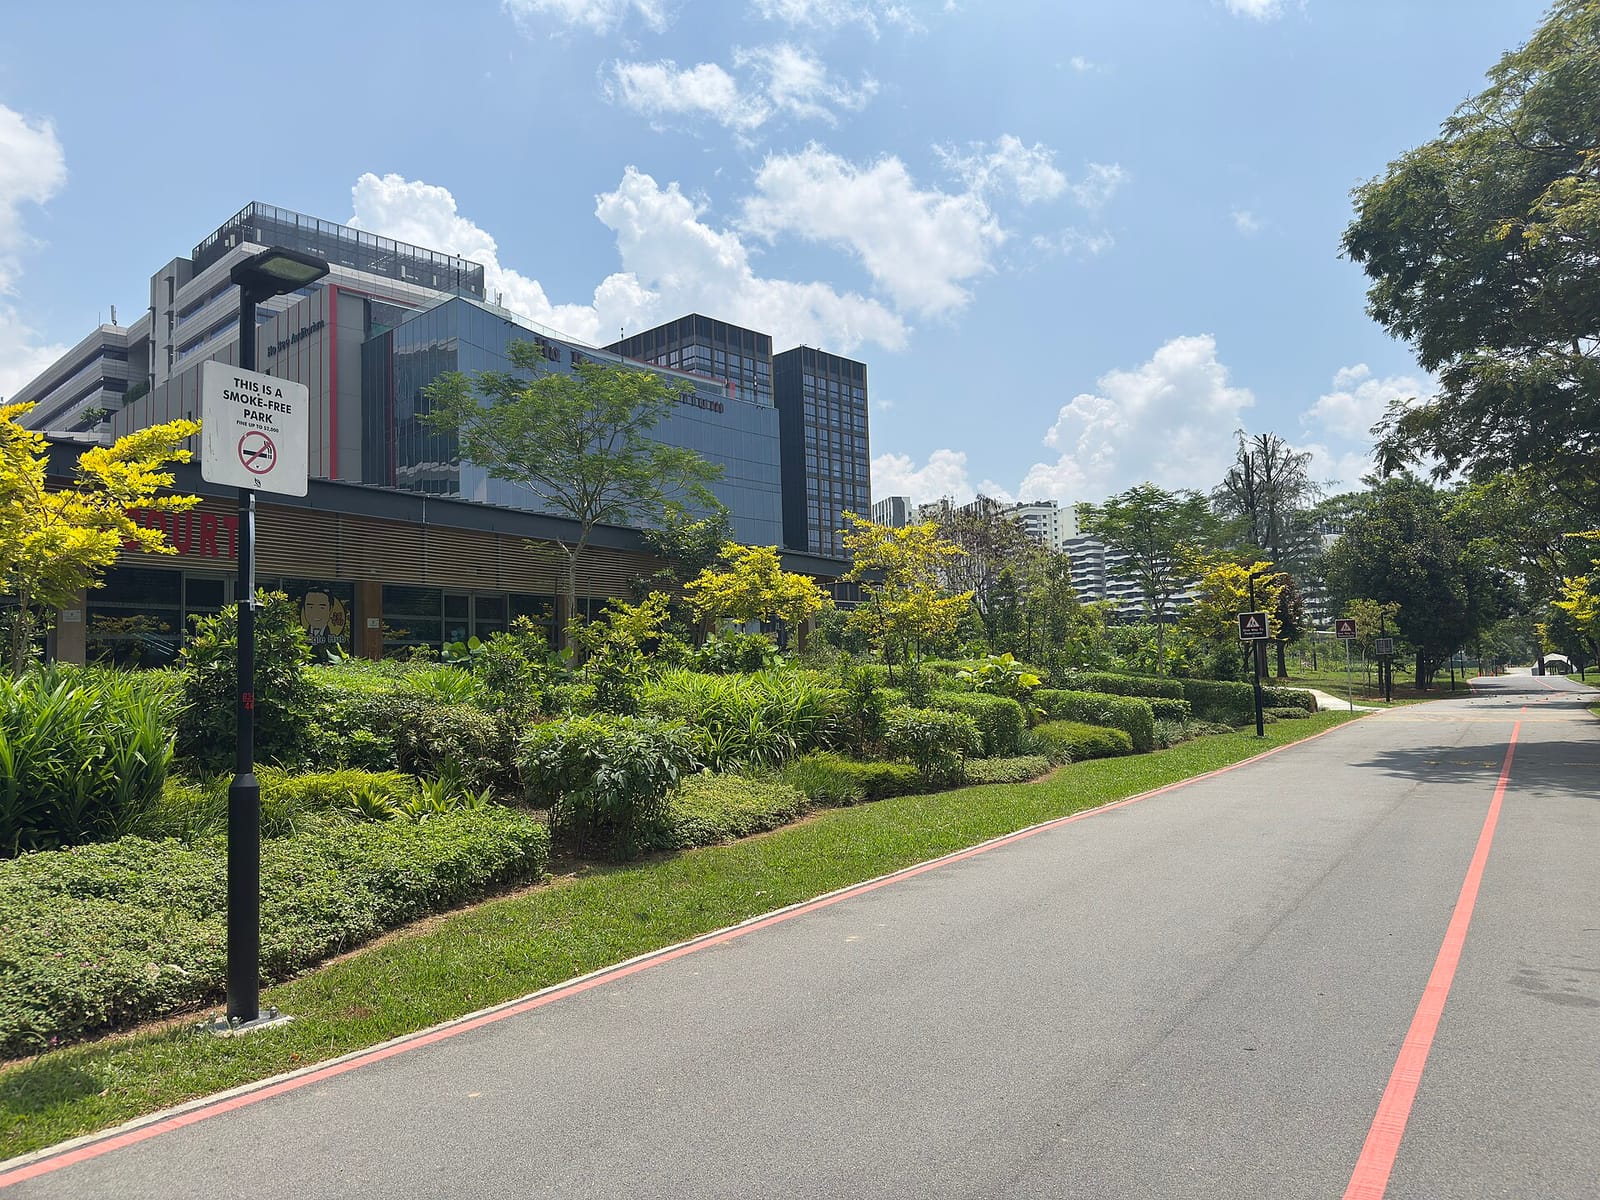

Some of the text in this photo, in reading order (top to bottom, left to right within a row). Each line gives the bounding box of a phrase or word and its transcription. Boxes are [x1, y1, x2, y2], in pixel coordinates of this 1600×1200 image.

[233, 377, 283, 399] THIS IS A
[222, 389, 292, 415] SMOKE-FREE
[243, 408, 273, 424] PARK
